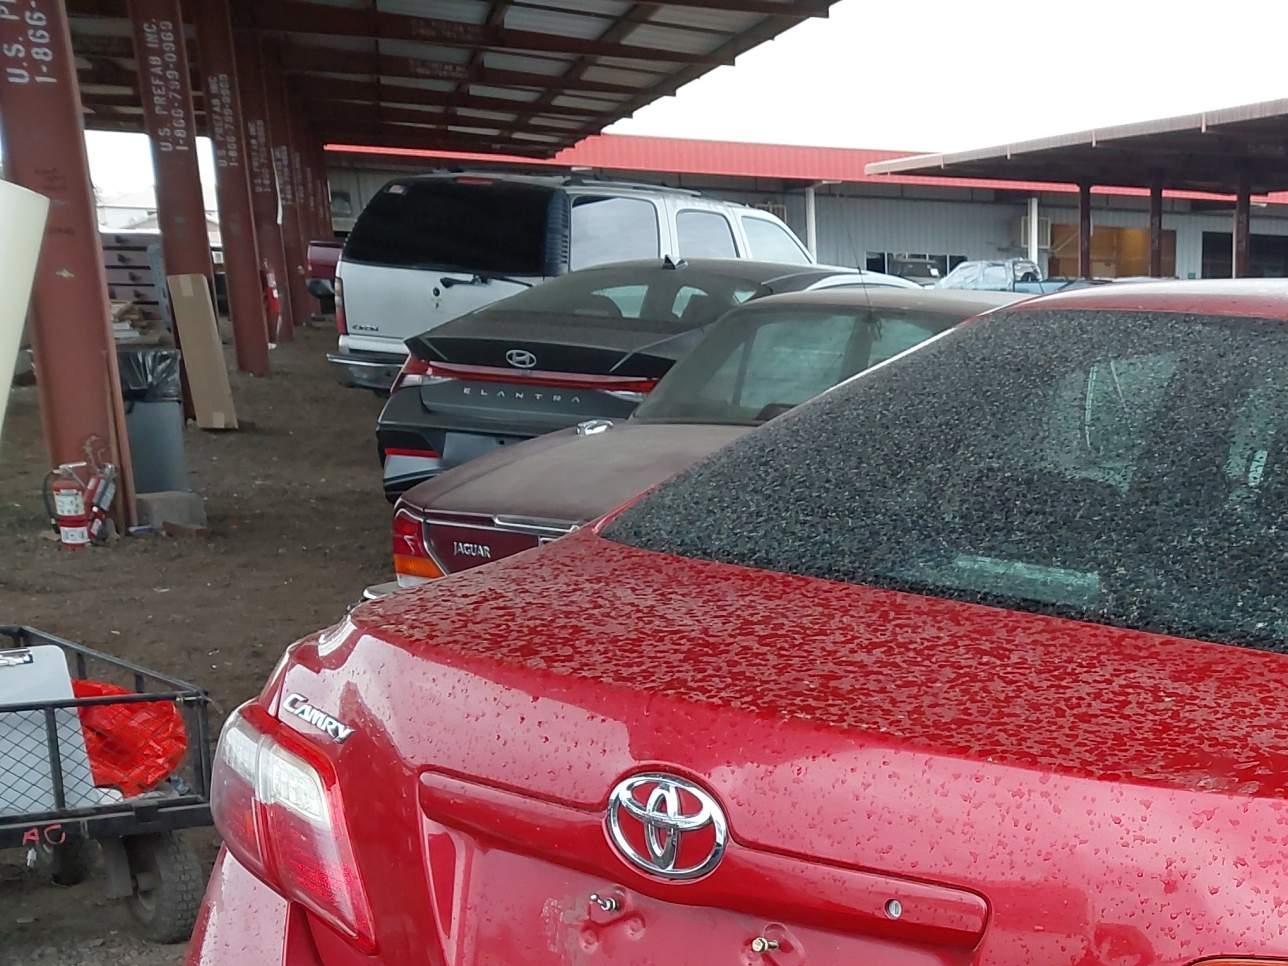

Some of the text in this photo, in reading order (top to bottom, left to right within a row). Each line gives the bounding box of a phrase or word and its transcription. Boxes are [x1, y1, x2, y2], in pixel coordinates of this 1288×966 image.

[3, 36, 30, 84] U.S.
[149, 55, 169, 115] PREFAB
[463, 387, 580, 403] ELANTRA
[453, 541, 491, 559] JAGUAR
[283, 693, 354, 744] CAMRY
